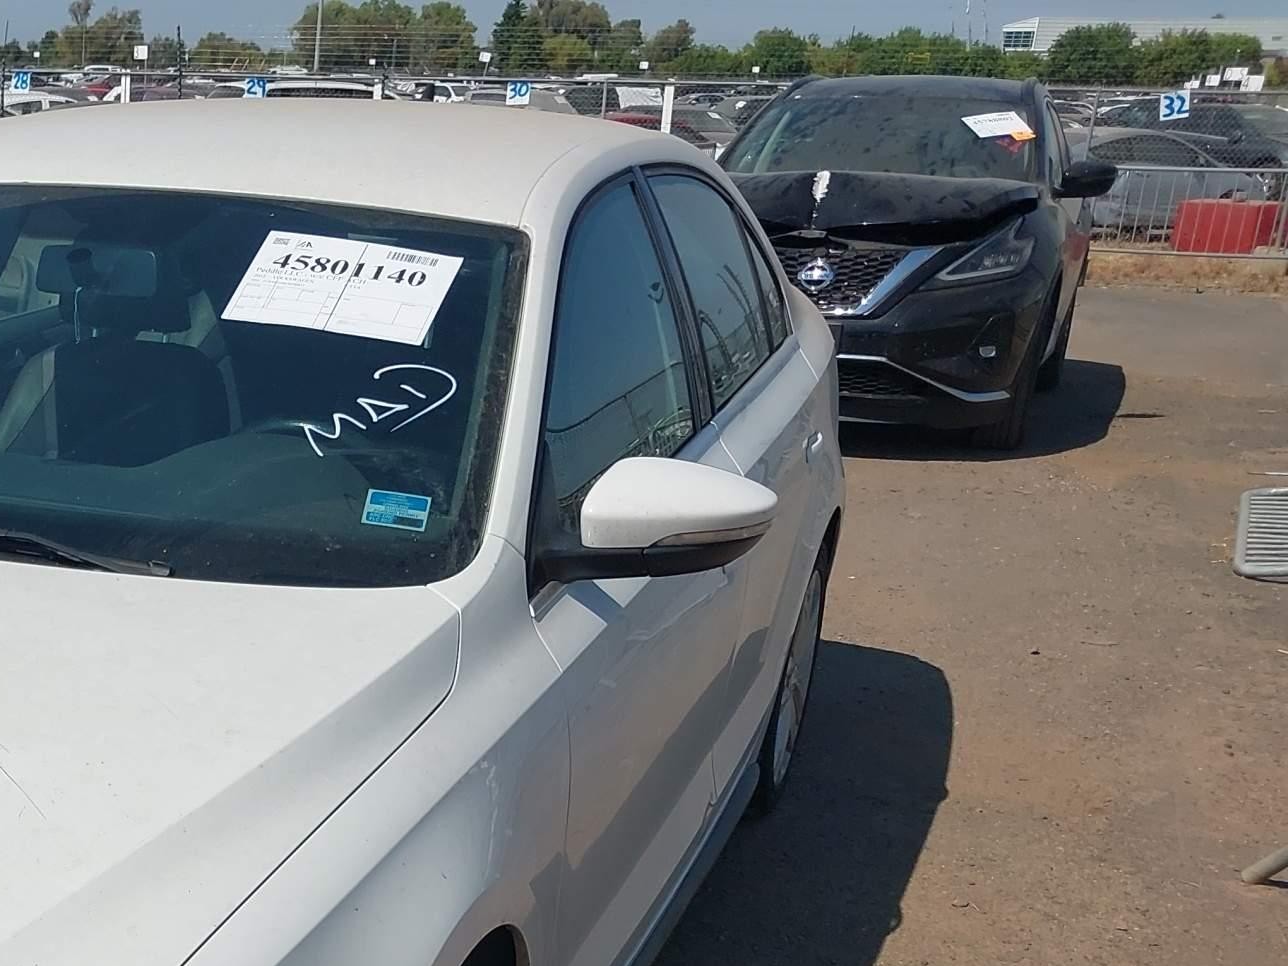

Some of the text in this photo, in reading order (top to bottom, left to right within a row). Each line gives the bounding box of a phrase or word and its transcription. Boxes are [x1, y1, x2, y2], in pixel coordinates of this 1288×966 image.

[13, 71, 29, 89] 28
[246, 78, 267, 97] 29
[508, 82, 529, 100] 30
[1162, 95, 1189, 117] 32
[273, 252, 427, 287] 45801140
